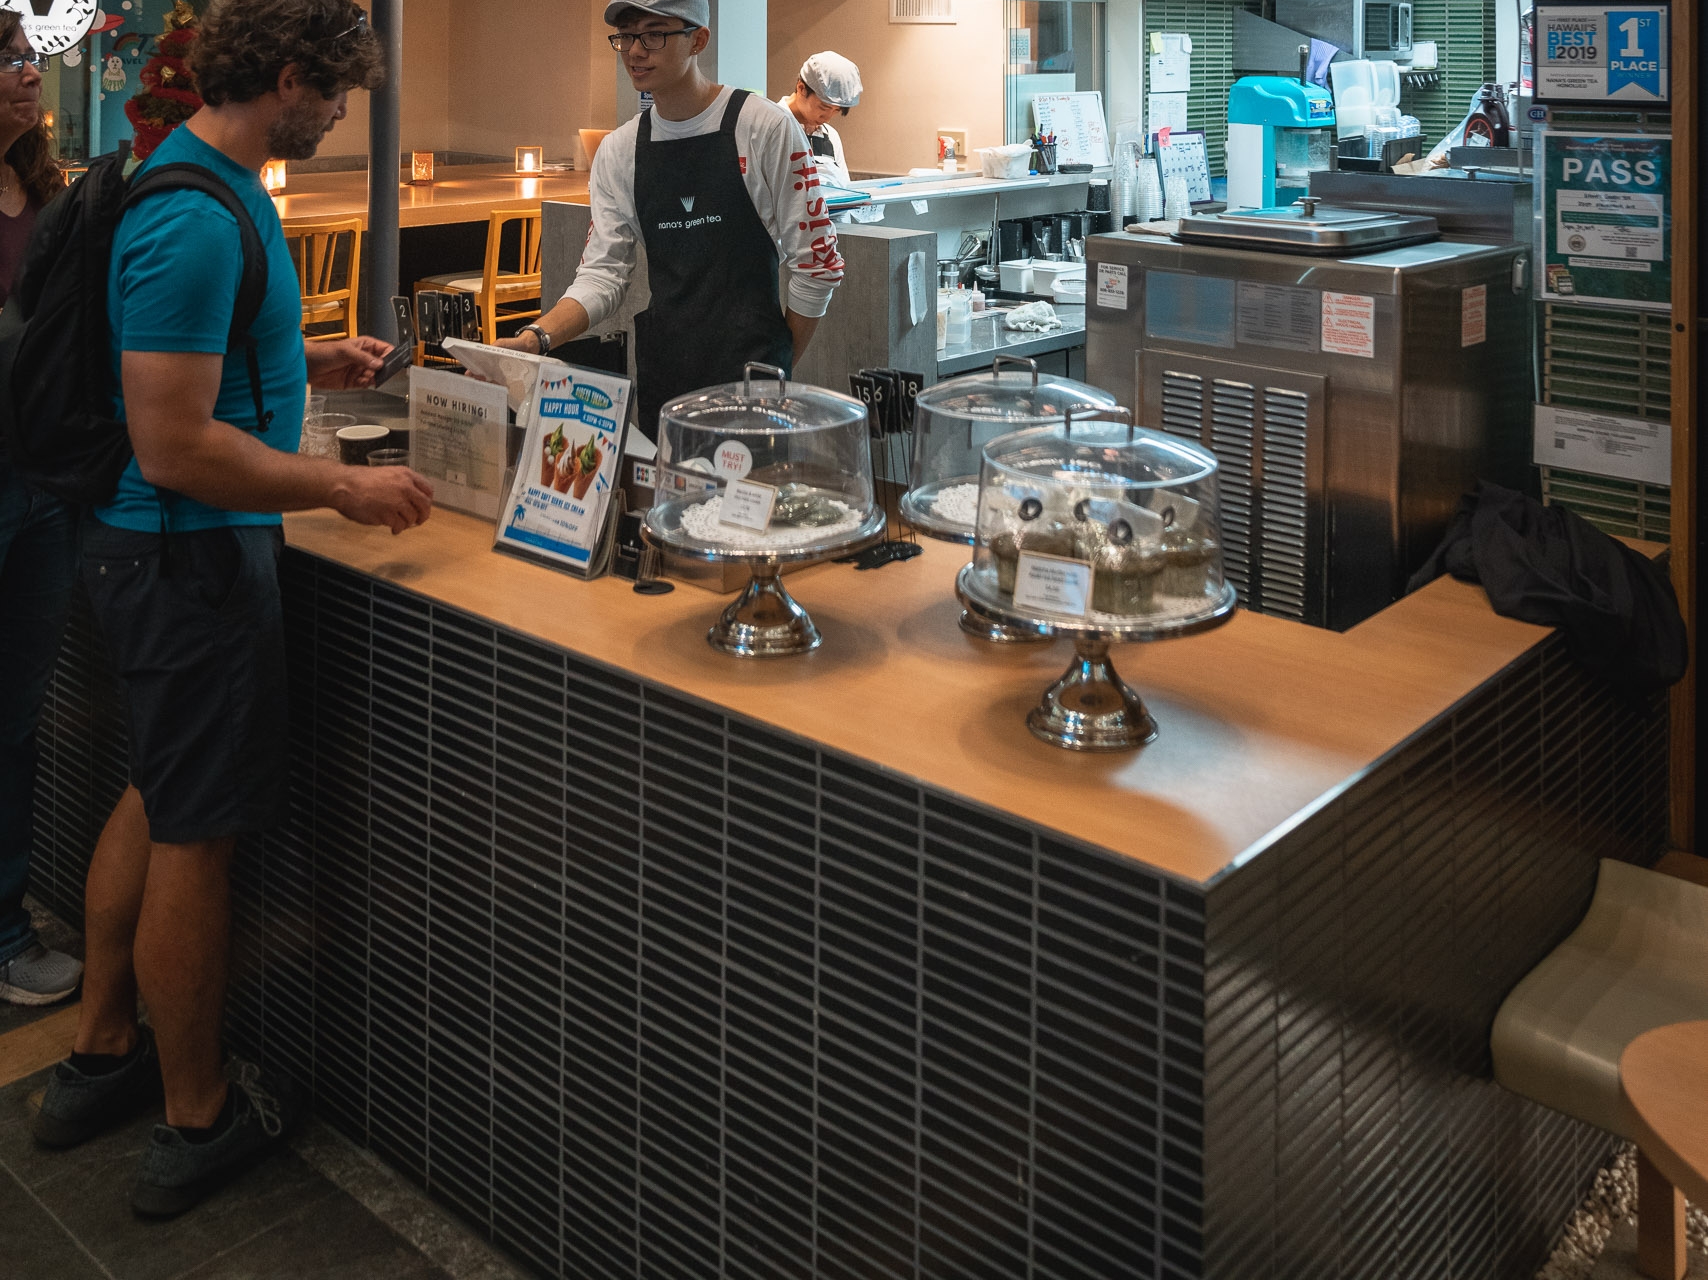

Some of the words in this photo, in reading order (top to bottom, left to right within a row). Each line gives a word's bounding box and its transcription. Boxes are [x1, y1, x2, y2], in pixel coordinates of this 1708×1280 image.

[35, 24, 61, 32] green
[1547, 24, 1597, 32] HAWAII'S
[1547, 32, 1596, 46] BEST
[1557, 46, 1597, 59] 2019
[1610, 61, 1657, 71] PLACE
[1563, 158, 1656, 186] PASS
[658, 220, 683, 230] nana's
[685, 217, 705, 229] green
[706, 214, 722, 223] tea
[799, 197, 832, 233] is
[400, 304, 406, 318] 2
[424, 302, 428, 315] 1
[464, 298, 471, 312] 3
[856, 385, 871, 404] 15
[901, 380, 918, 398] 18
[426, 394, 448, 408] NOW
[452, 400, 487, 419] HIRING!
[543, 402, 561, 414] HAPPY
[563, 402, 580, 414] HOUR
[721, 449, 745, 462] MUST
[722, 460, 742, 471] TRY!
